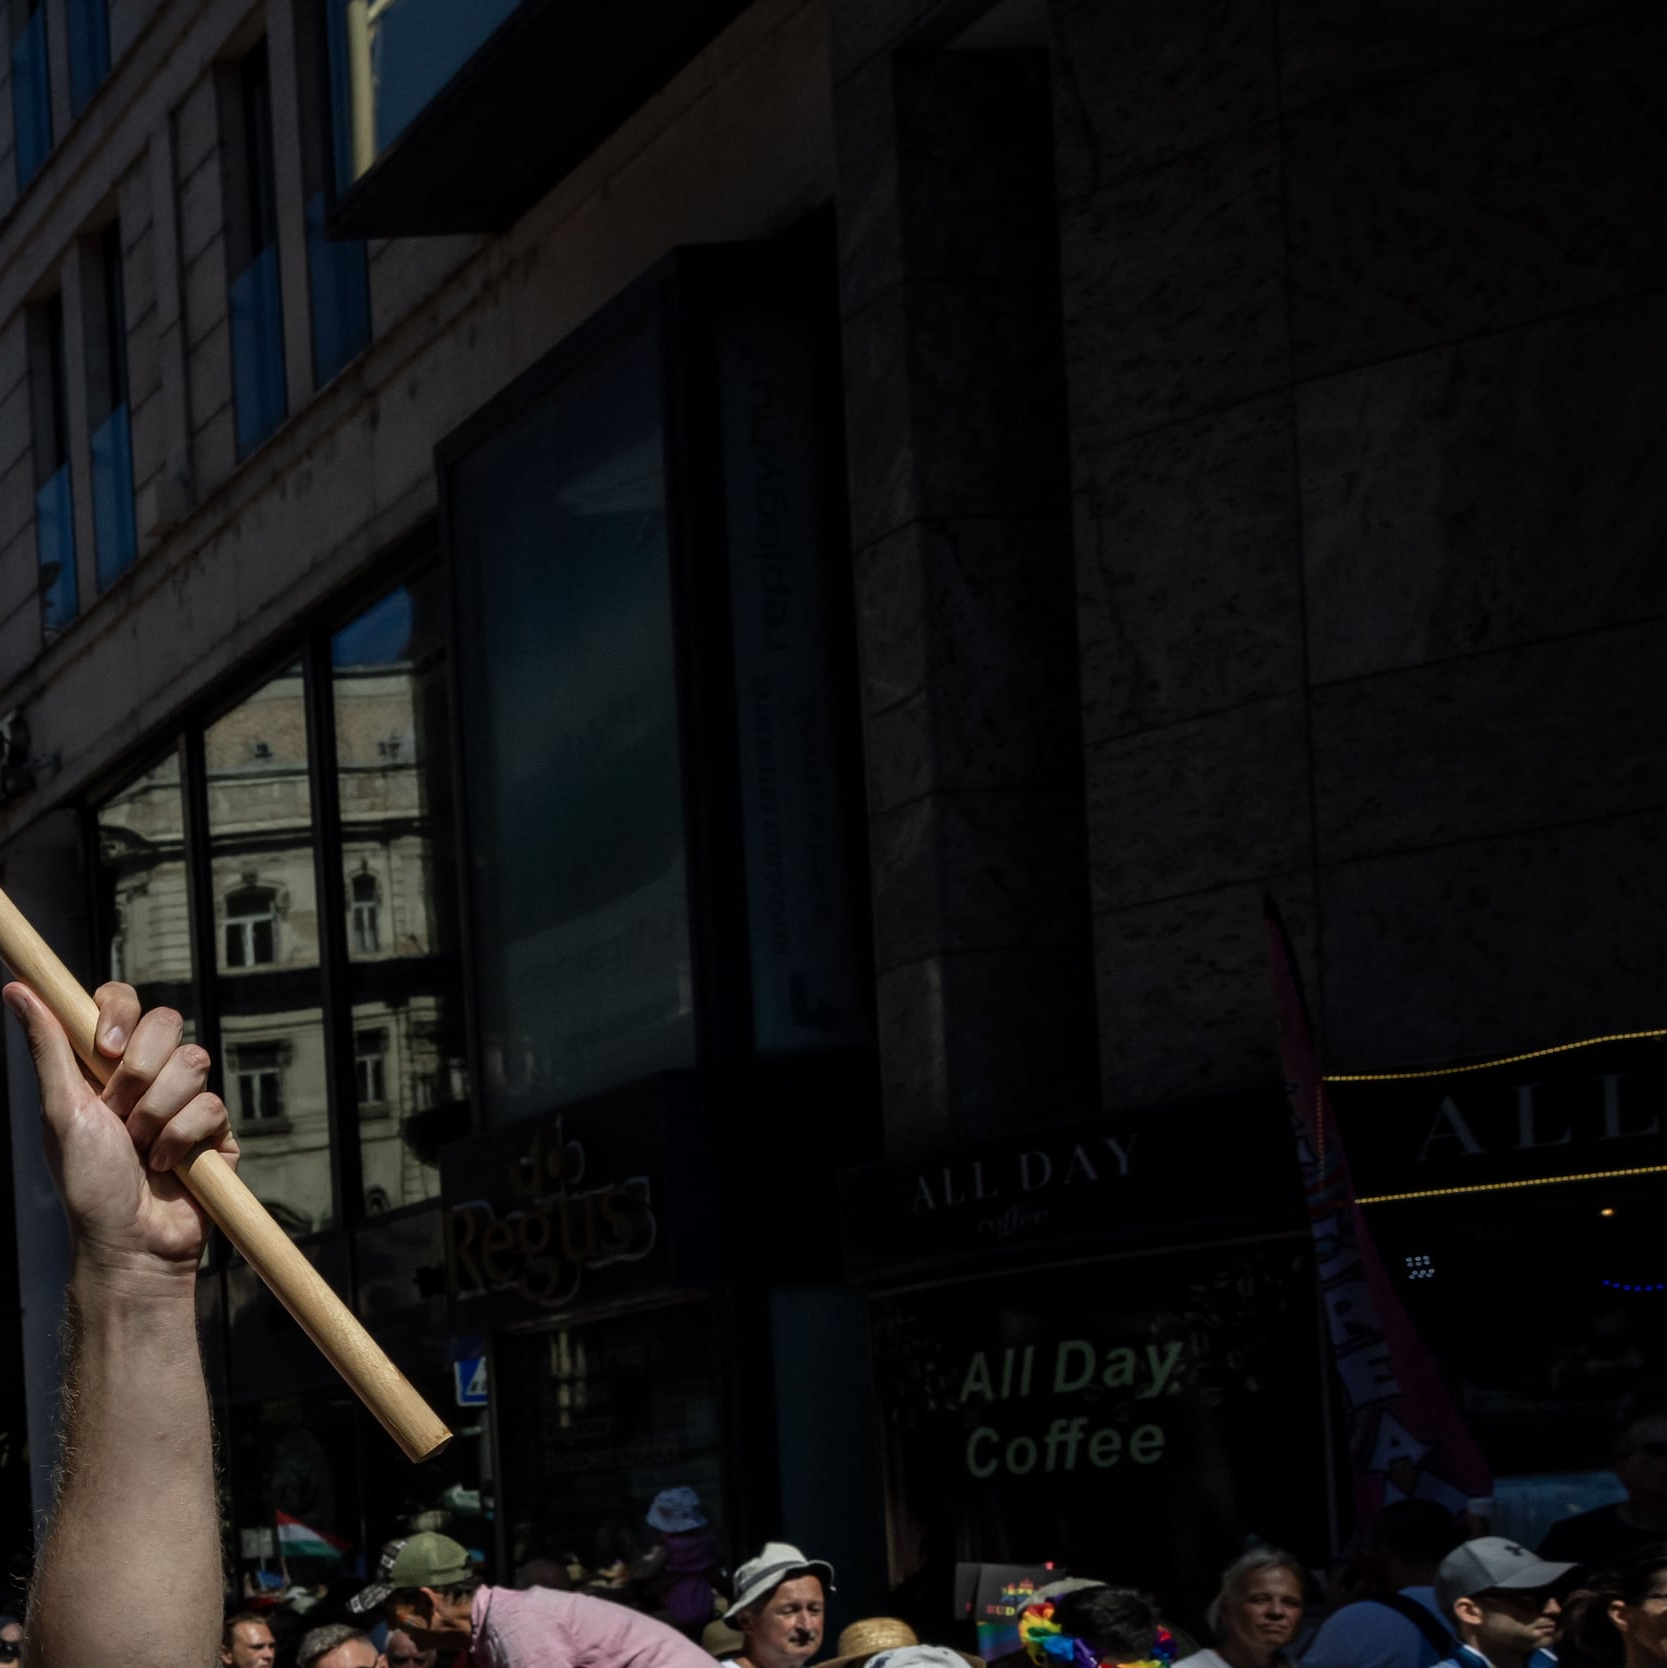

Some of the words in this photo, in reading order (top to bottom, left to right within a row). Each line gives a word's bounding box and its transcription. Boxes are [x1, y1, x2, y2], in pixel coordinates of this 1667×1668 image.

[1416, 1071, 1660, 1164] ALL
[911, 1159, 1000, 1214] ALL
[1017, 1132, 1140, 1193] DAY
[958, 1344, 1035, 1405] All
[1051, 1337, 1184, 1401] Day
[966, 1416, 1167, 1480] Coffee
